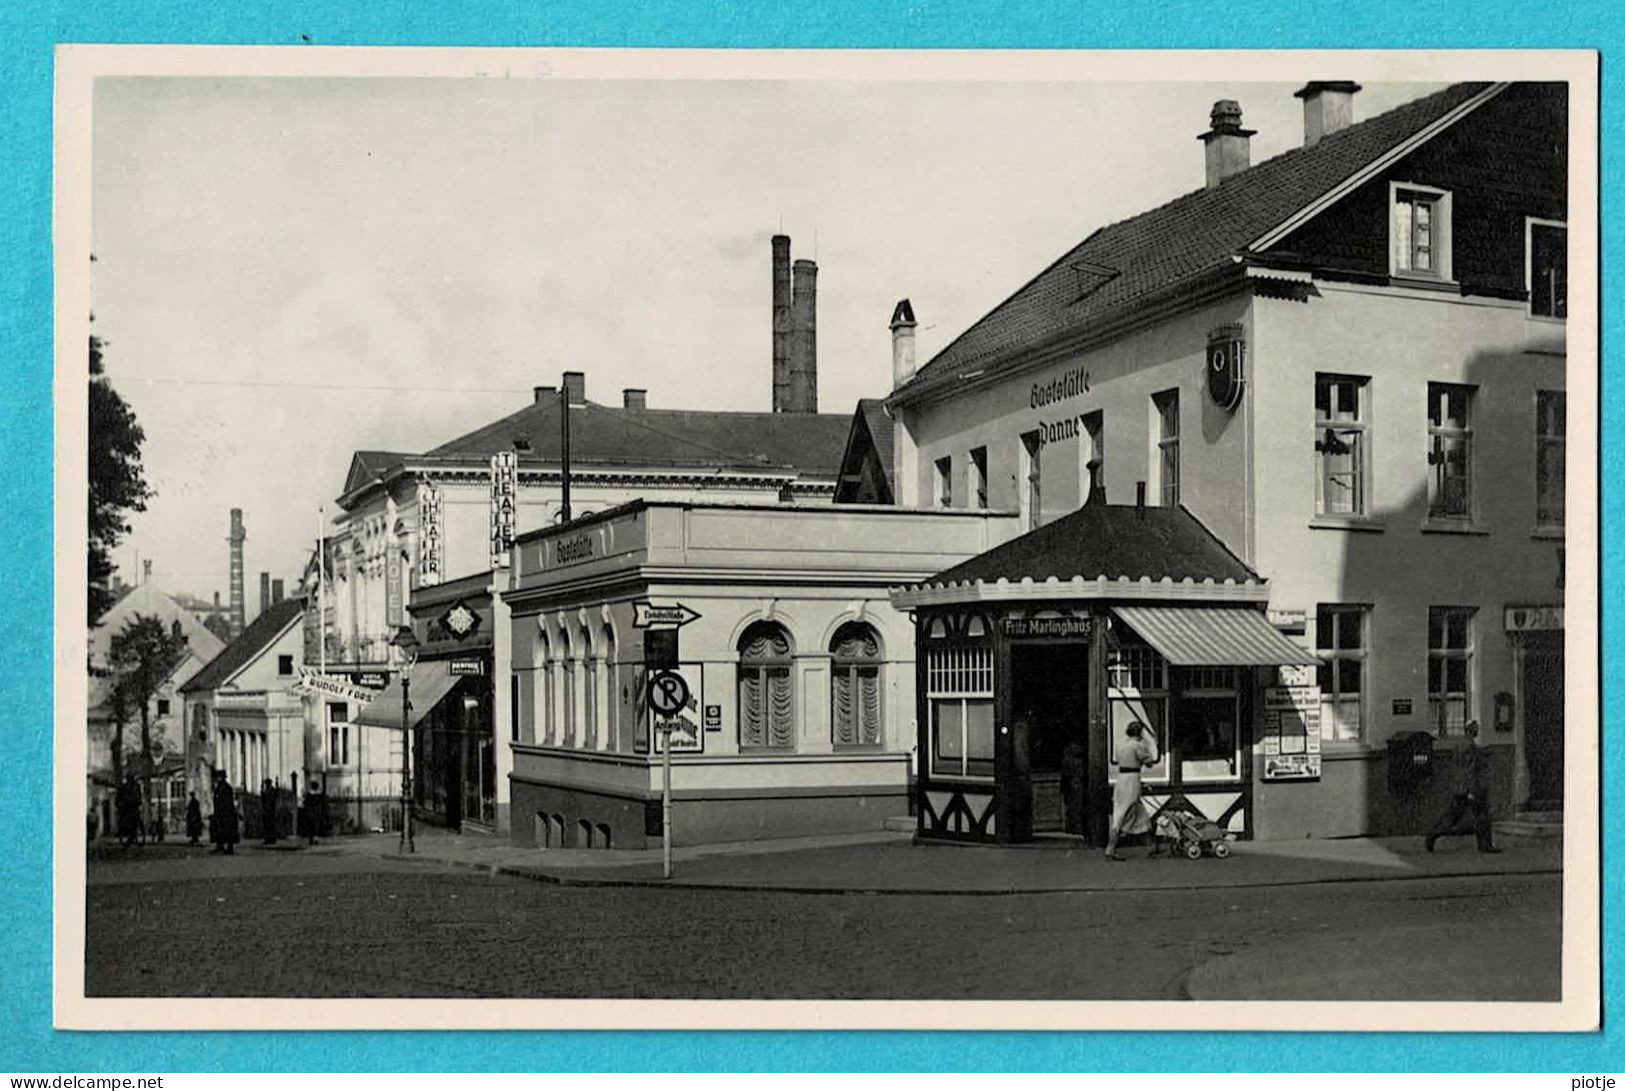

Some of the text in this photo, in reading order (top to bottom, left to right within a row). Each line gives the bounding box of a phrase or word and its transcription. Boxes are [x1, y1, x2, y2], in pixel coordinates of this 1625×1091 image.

[1030, 366, 1090, 410] Gaststätte
[429, 488, 438, 573] THEATER
[388, 548, 400, 623] HOTEL
[1005, 620, 1027, 634] Fritz
